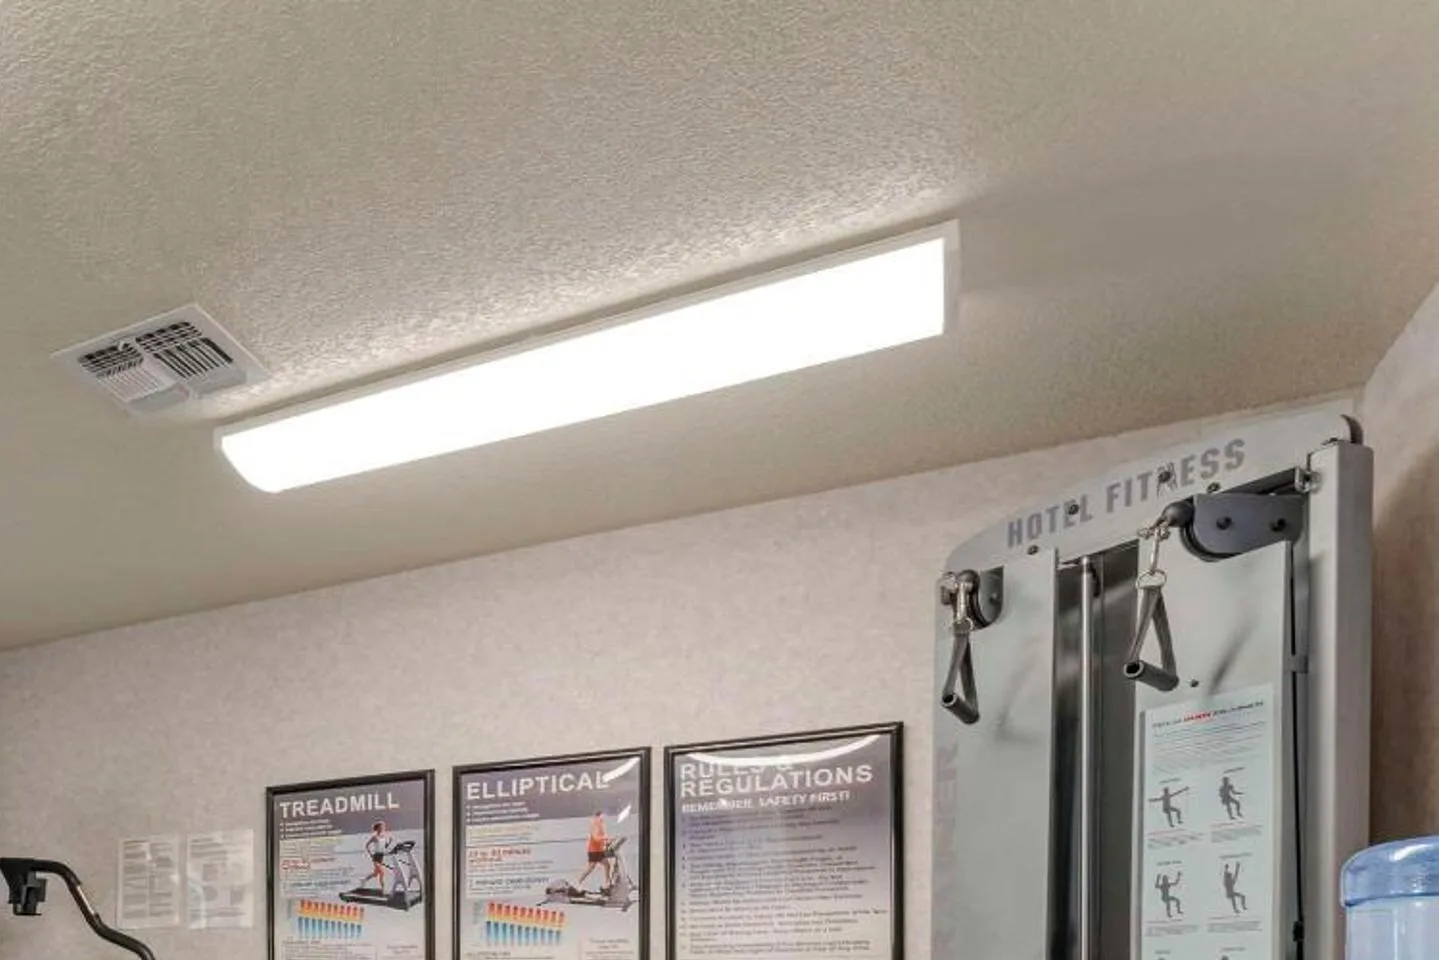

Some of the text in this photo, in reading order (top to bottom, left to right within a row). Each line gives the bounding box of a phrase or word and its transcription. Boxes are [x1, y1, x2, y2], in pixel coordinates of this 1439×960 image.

[1007, 437, 1245, 549] HOTEL FITNESS
[466, 771, 610, 800] ELLIPTICAL
[681, 764, 874, 798] REGULATIONS
[279, 792, 400, 819] TREADMILL
